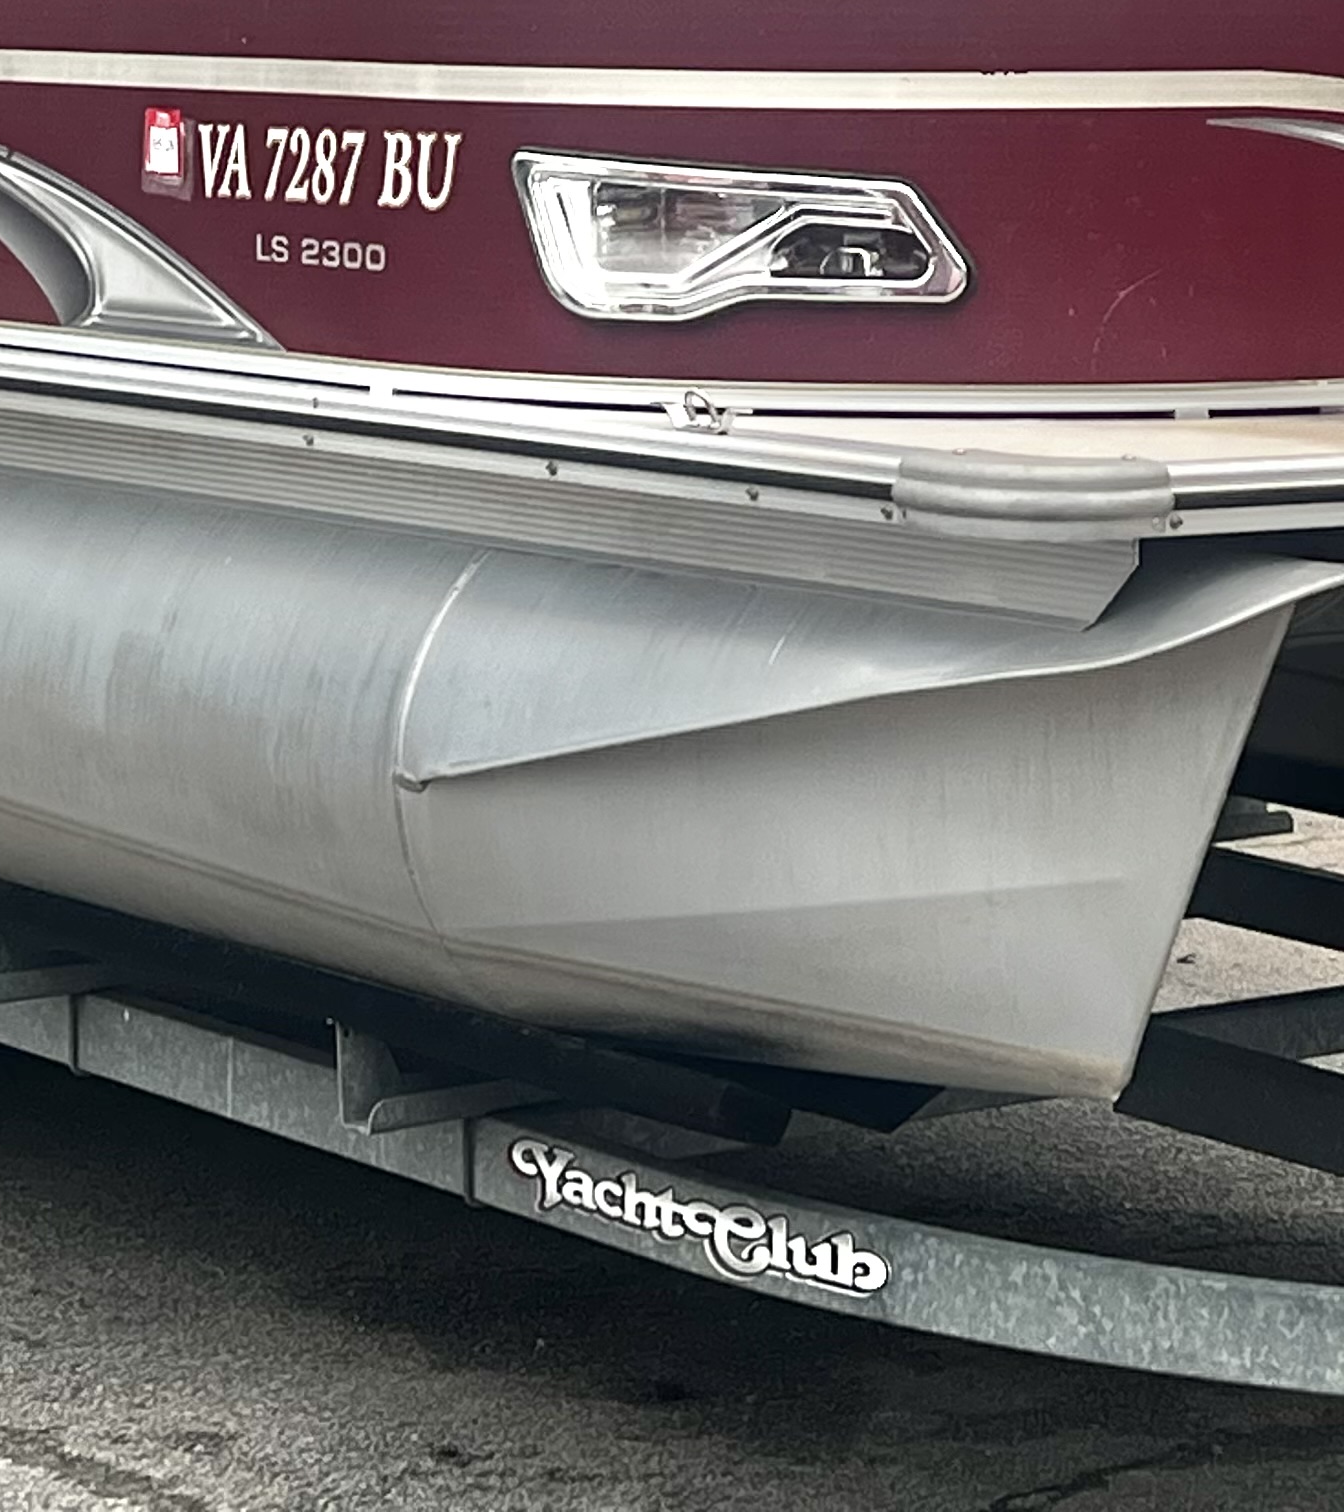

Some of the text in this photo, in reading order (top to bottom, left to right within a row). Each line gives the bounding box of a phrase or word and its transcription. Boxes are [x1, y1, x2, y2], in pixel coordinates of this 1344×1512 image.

[197, 123, 462, 211] VA 7287 BU
[256, 233, 386, 271] LS 2300
[510, 1138, 890, 1292] Yacht Club
